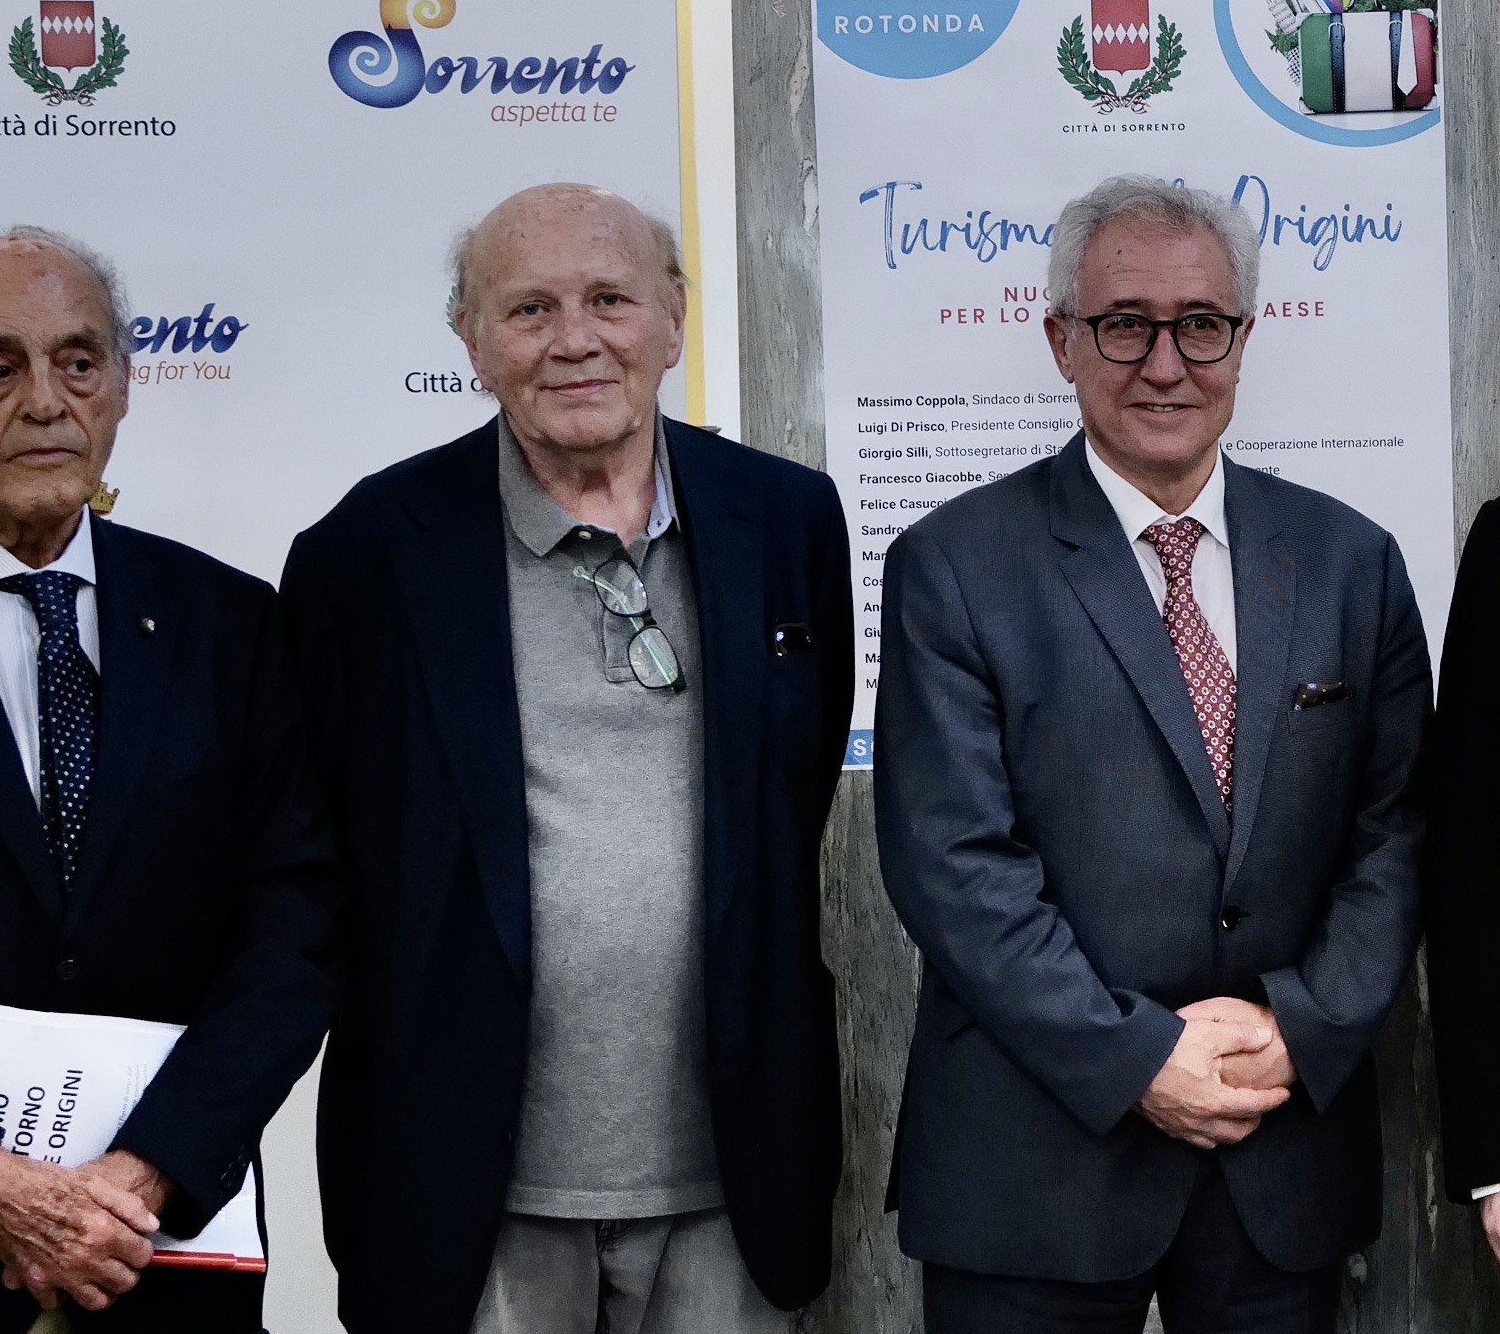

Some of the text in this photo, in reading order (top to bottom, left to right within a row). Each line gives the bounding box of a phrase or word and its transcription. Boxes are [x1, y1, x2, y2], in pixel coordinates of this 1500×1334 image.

[834, 13, 986, 34] ROTONDA
[491, 102, 617, 127] aspetta te
[35, 114, 56, 135] di
[66, 115, 176, 136] Sorrento
[1063, 123, 1097, 132] CITTÀ
[1122, 123, 1185, 132] SORRENTO
[941, 309, 984, 324] PER
[1001, 308, 1029, 323] LO
[1263, 302, 1324, 317] AESE
[129, 303, 249, 354] ento
[157, 361, 189, 384] for
[193, 362, 230, 379] You
[405, 372, 462, 392] Città
[857, 393, 1077, 409] Massimo Coppola, Sindaco di Sorren
[858, 418, 1073, 435] Luigi Di Prisco, Presidente Consiglio
[858, 444, 1064, 461] Giorgio Silli, Sottosegretario di Sta
[1226, 436, 1404, 452] e Cooperazione Internazionale
[860, 474, 921, 484] Francesco
[926, 471, 985, 485] Giacobbe,
[860, 499, 896, 510] Felice
[861, 524, 903, 535] Sandro
[862, 551, 886, 561] Mar
[863, 576, 884, 586] Cos
[864, 627, 881, 637] Giu
[48, 1068, 83, 1149] ORIGINI
